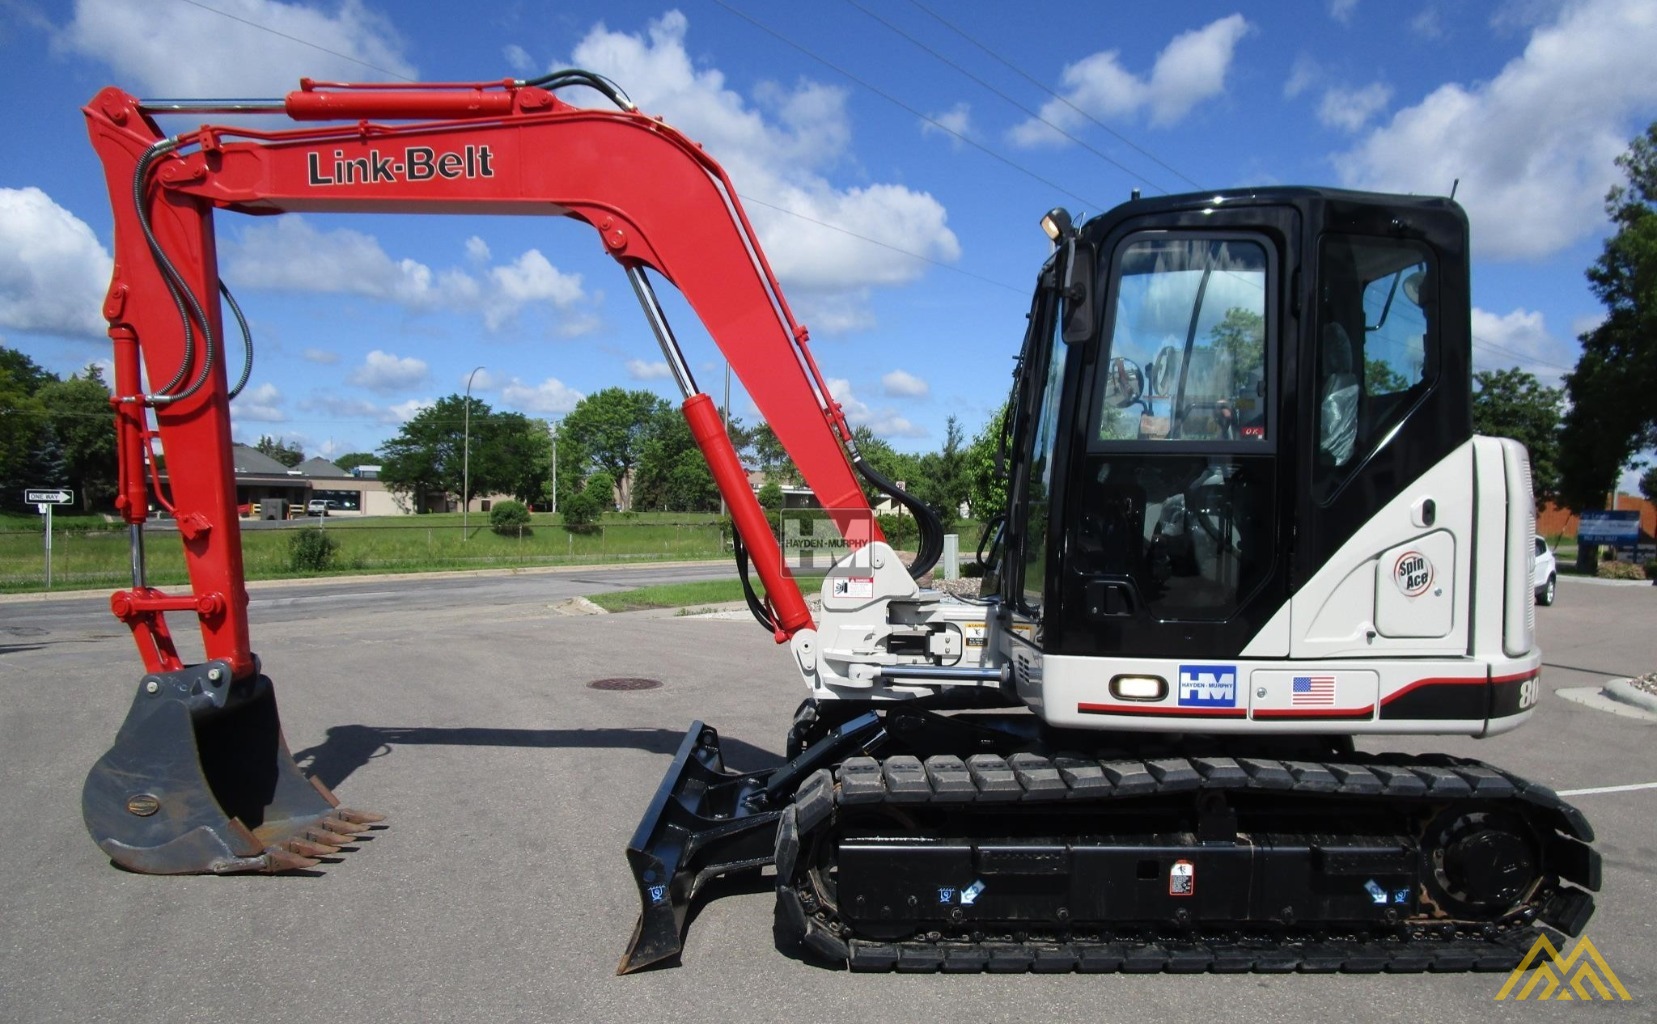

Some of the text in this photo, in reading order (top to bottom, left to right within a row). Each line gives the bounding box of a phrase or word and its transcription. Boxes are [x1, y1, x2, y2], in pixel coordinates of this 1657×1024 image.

[308, 145, 494, 186] Link-Belt
[1399, 557, 1424, 577] Spin
[1406, 572, 1428, 590] Ace
[1519, 676, 1540, 709] 80
